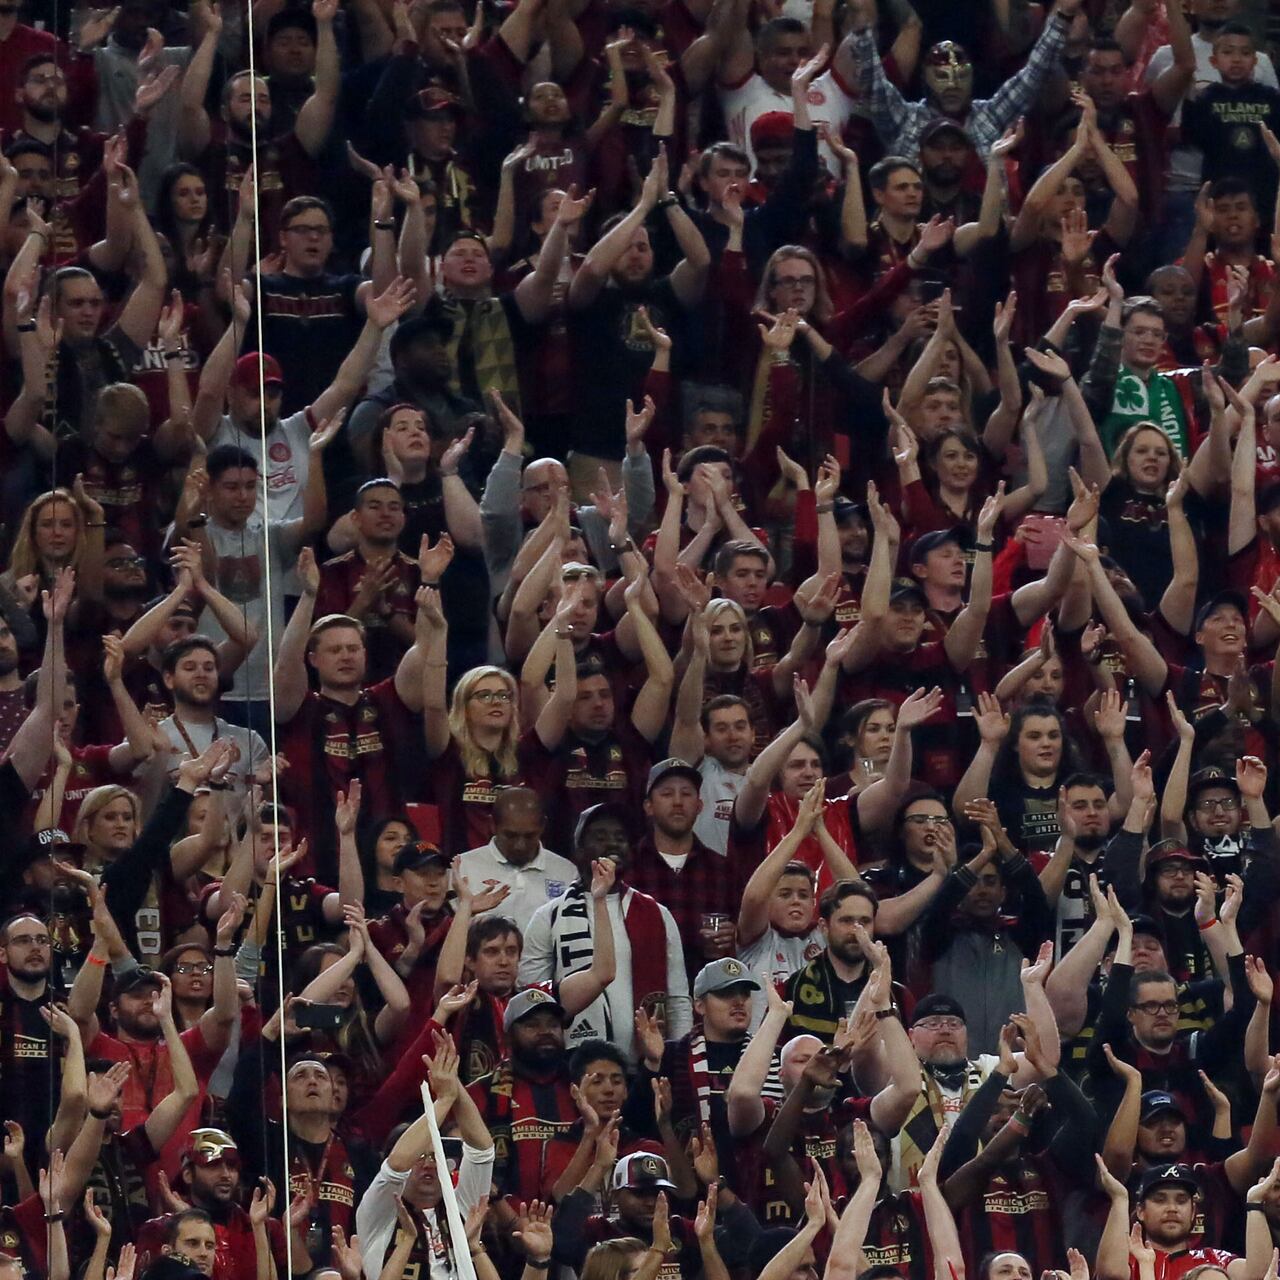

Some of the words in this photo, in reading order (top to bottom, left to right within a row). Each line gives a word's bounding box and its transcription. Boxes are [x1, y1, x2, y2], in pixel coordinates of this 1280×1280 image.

[1211, 102, 1271, 115] ATLANTA
[1221, 113, 1263, 124] UNITED
[569, 1029, 599, 1040] adidas
[511, 1124, 555, 1134] AMERICAN
